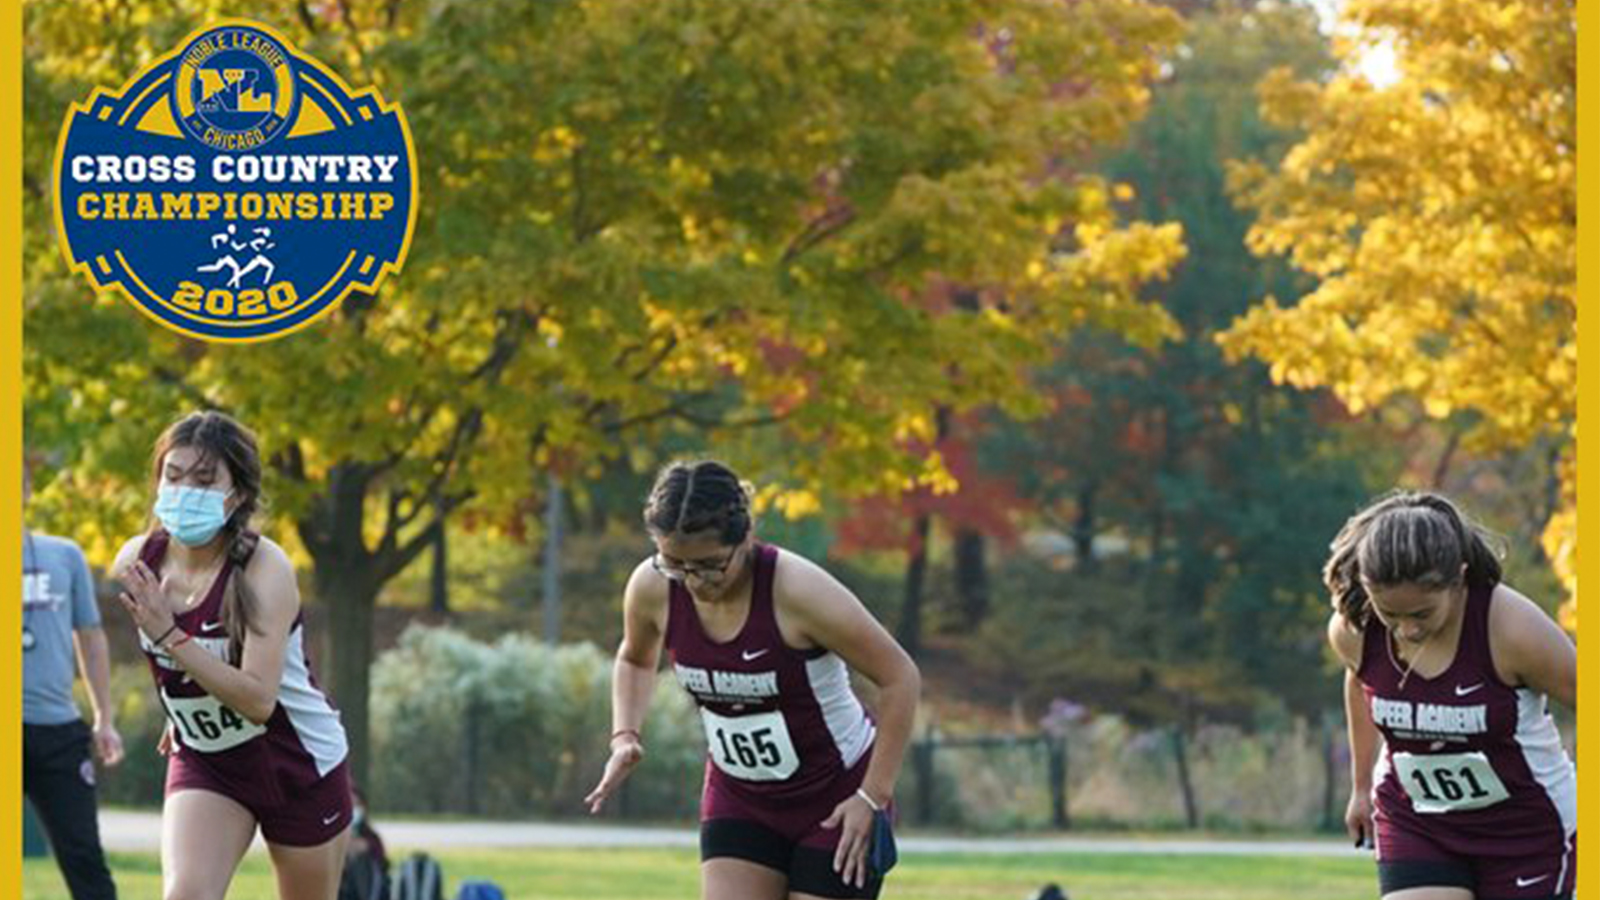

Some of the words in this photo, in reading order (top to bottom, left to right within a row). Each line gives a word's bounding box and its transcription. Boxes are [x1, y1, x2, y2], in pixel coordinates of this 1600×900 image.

[712, 671, 779, 697] ACADEMY
[175, 705, 243, 740] 164
[1416, 703, 1487, 735] ACADEMY
[716, 728, 782, 768] 165
[1412, 766, 1489, 800] 161
